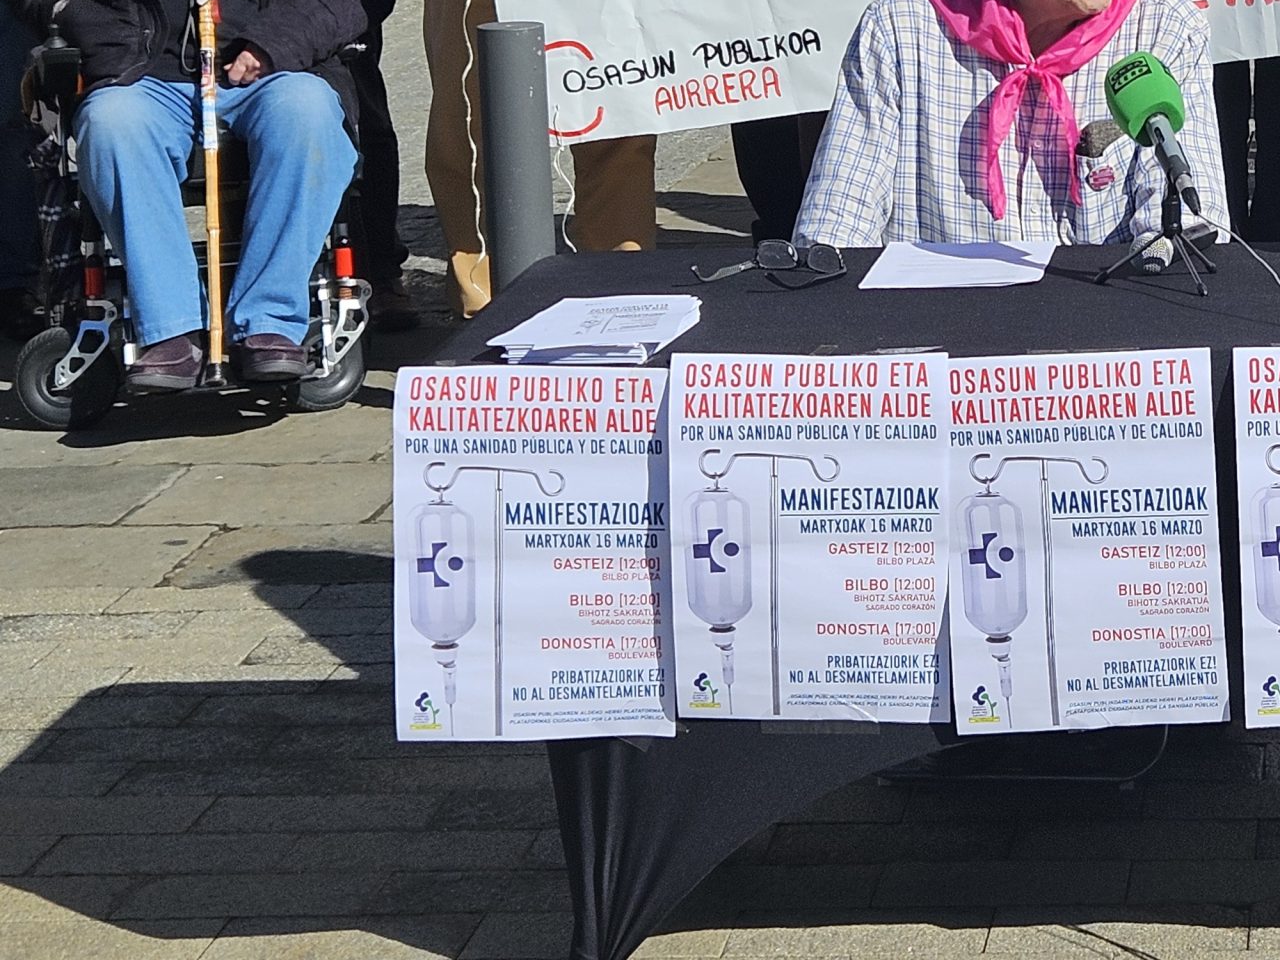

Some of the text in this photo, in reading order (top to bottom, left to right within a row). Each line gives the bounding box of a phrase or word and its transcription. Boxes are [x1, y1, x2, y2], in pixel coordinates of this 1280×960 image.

[563, 28, 821, 92] OSASUN PUBLIKOA
[655, 66, 781, 114] AURRERA
[685, 362, 929, 388] OSASUN PUBLIKO ETA
[949, 360, 1192, 395] OSASUN PUBLIKO ETA
[408, 375, 654, 402] OSASUN PUBLIKO ETA
[684, 393, 931, 419] KALITATEZKOAREN ALDE
[951, 390, 1196, 425] KALITATEZKOAREN ALDE
[408, 407, 656, 433] KALITATEZKOAREN ALDE
[681, 421, 937, 441] POR UNA SANIDAD PÚBLICA Y DE CALIDAD
[1247, 421, 1270, 437] POR
[405, 436, 662, 455] POR UNA SANIDAD PÚBLICA Y DE CALIDAD
[950, 422, 1203, 447] POR UNA SANIDAD PÚBLICA Y DE CALIDAD
[781, 487, 939, 511] MANIFESTAZIOAK
[1050, 486, 1208, 515] MANIFESTAZIOAK
[505, 502, 663, 526] MANIFESTAZIOAK
[800, 518, 933, 534] MARTXOAK 16 MARZO
[1072, 520, 1203, 538] MARTXOAK 16 MARZO
[525, 534, 658, 549] MARTXOAK 16 MARZO
[827, 654, 939, 670] PRIBATIZAZIORIK EZ!
[1104, 656, 1216, 674] PRIBATIZAZIORIK EZ!
[552, 668, 665, 684] PRIBATIZAZIORIK EZ!
[789, 669, 940, 685] NO AL DESMANTELAMIENTO
[1067, 673, 1217, 692] NO AL DESMANTELAMIENTO
[513, 684, 664, 701] NO AL DESMANTELAMIENTO
